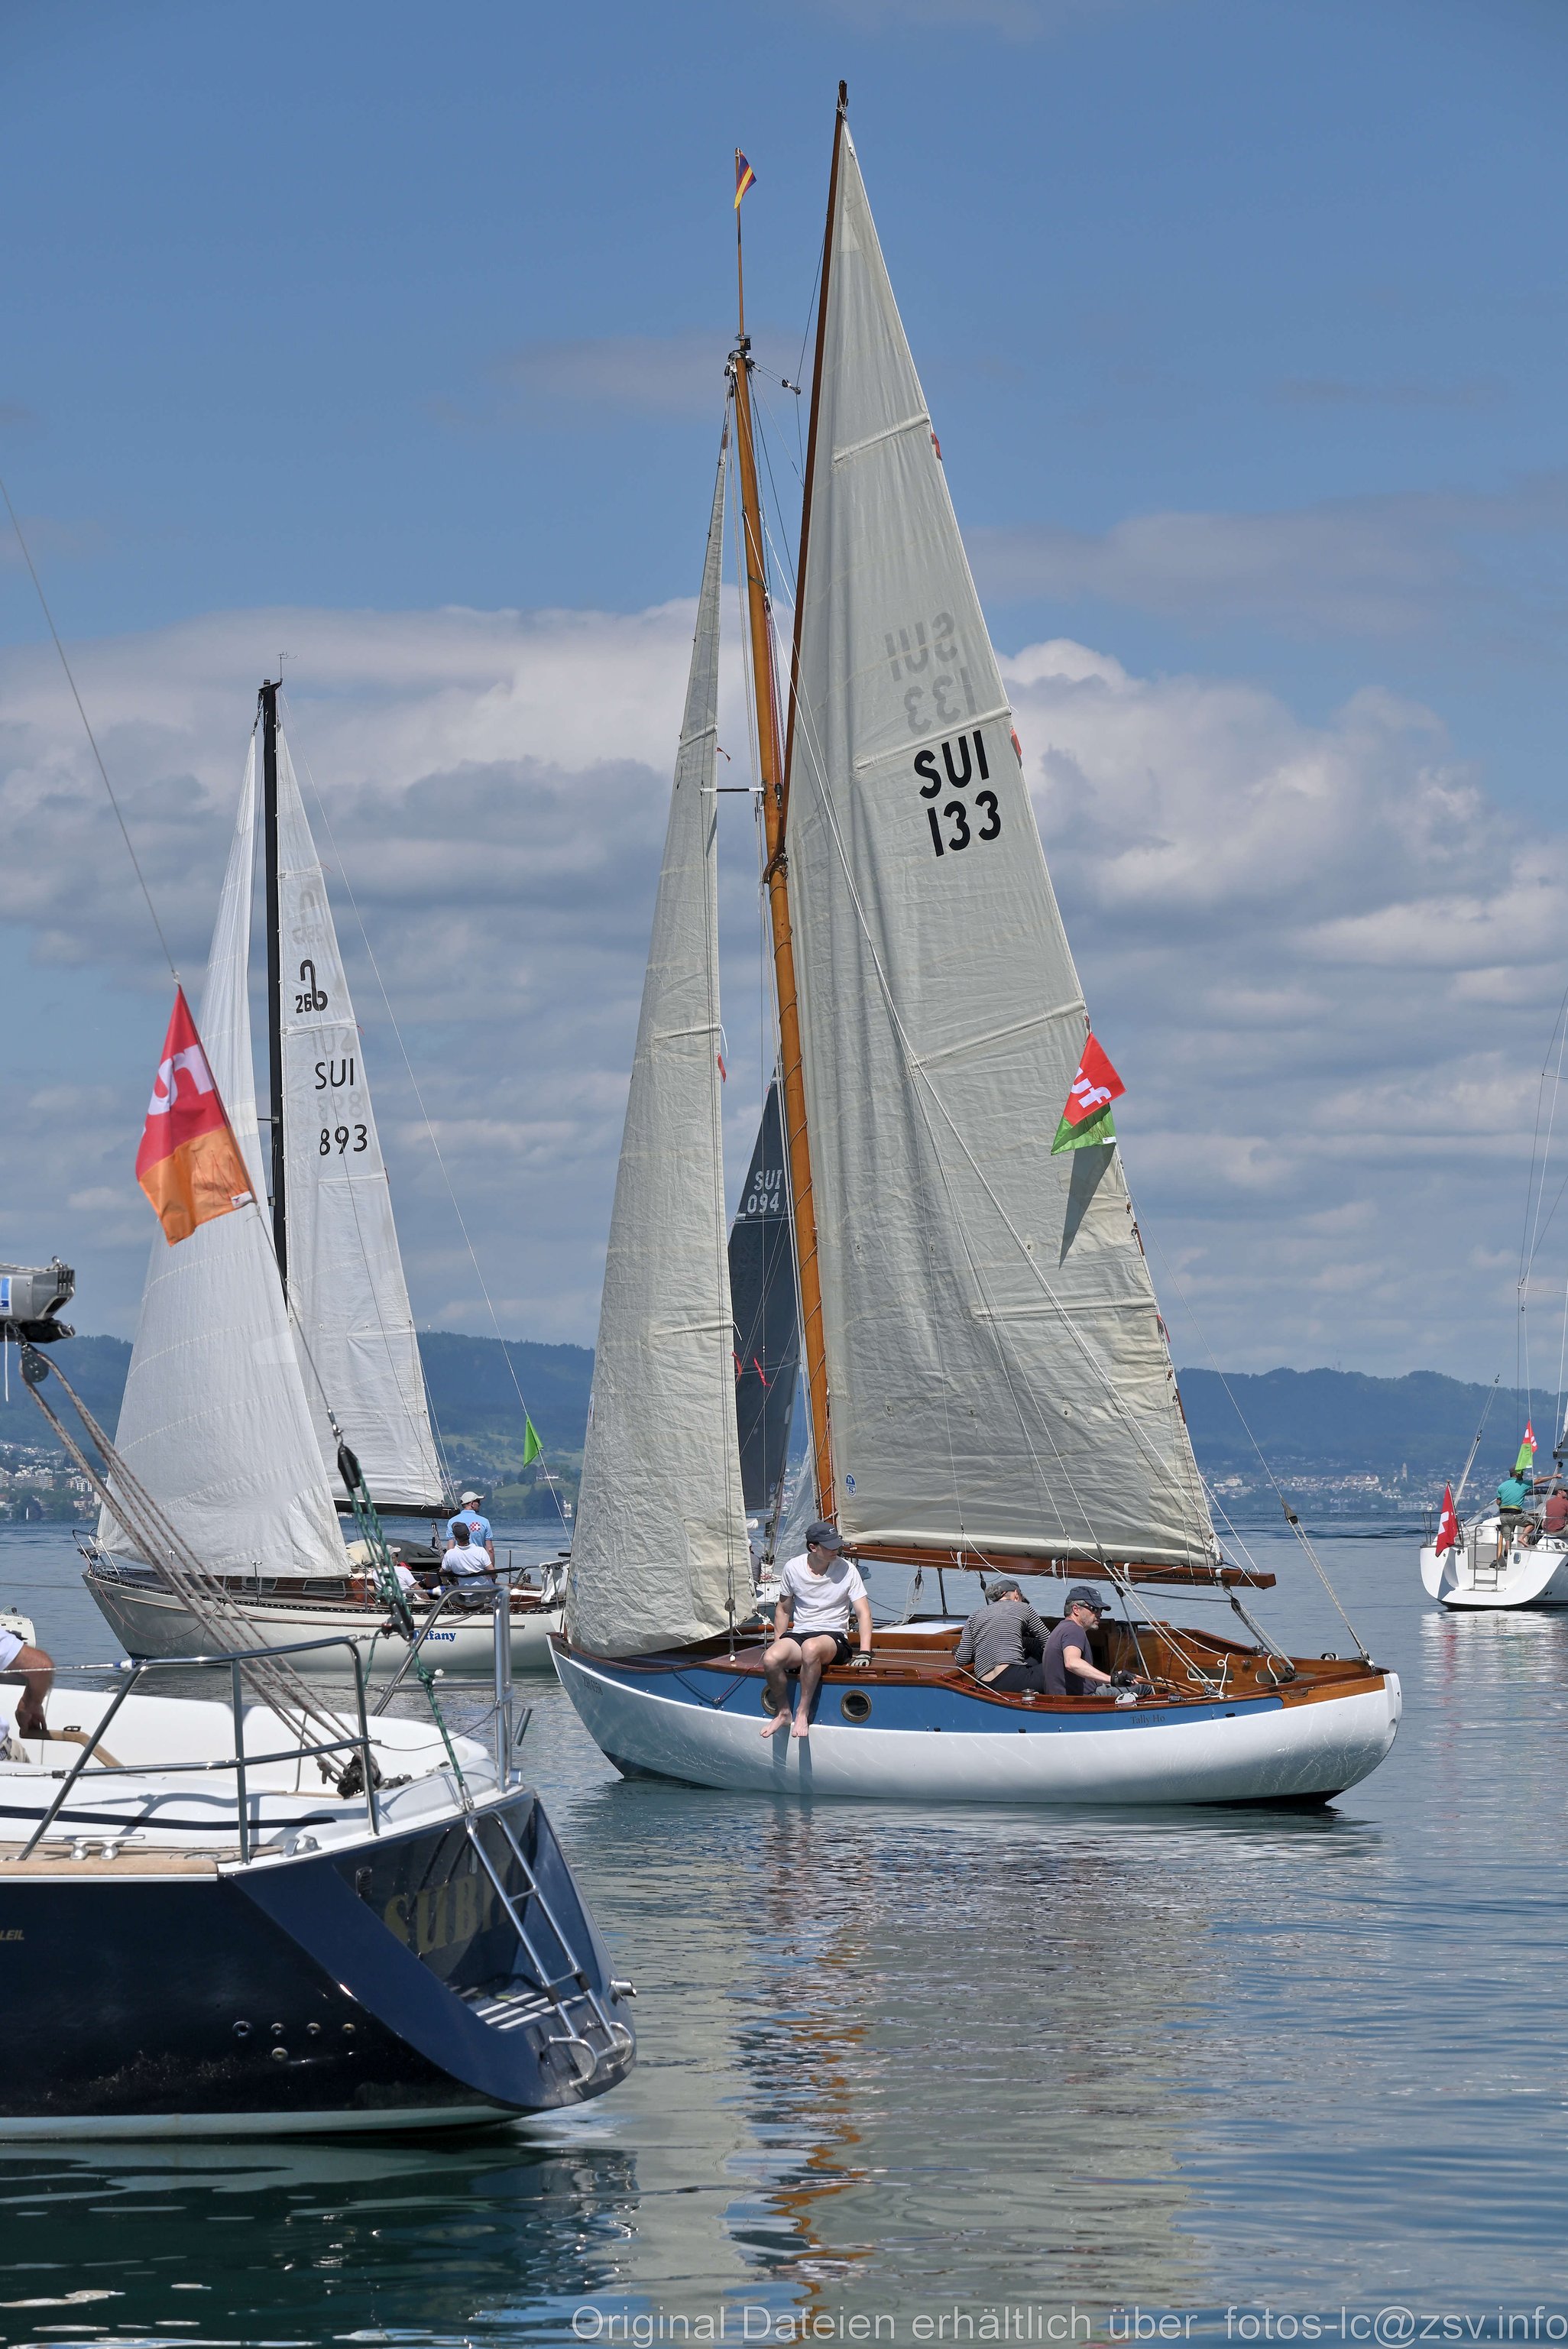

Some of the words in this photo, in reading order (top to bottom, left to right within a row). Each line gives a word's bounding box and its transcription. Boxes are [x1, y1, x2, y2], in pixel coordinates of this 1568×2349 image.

[914, 730, 990, 799] SUI
[927, 790, 1001, 857] 133
[315, 1058, 354, 1090] SUI
[319, 1124, 368, 1155] 893
[753, 1169, 782, 1191] SUI
[747, 1192, 779, 1214] 094
[412, 1629, 456, 1641] Tfany
[1130, 1714, 1149, 1725] Tally
[1152, 1714, 1165, 1722] Ho
